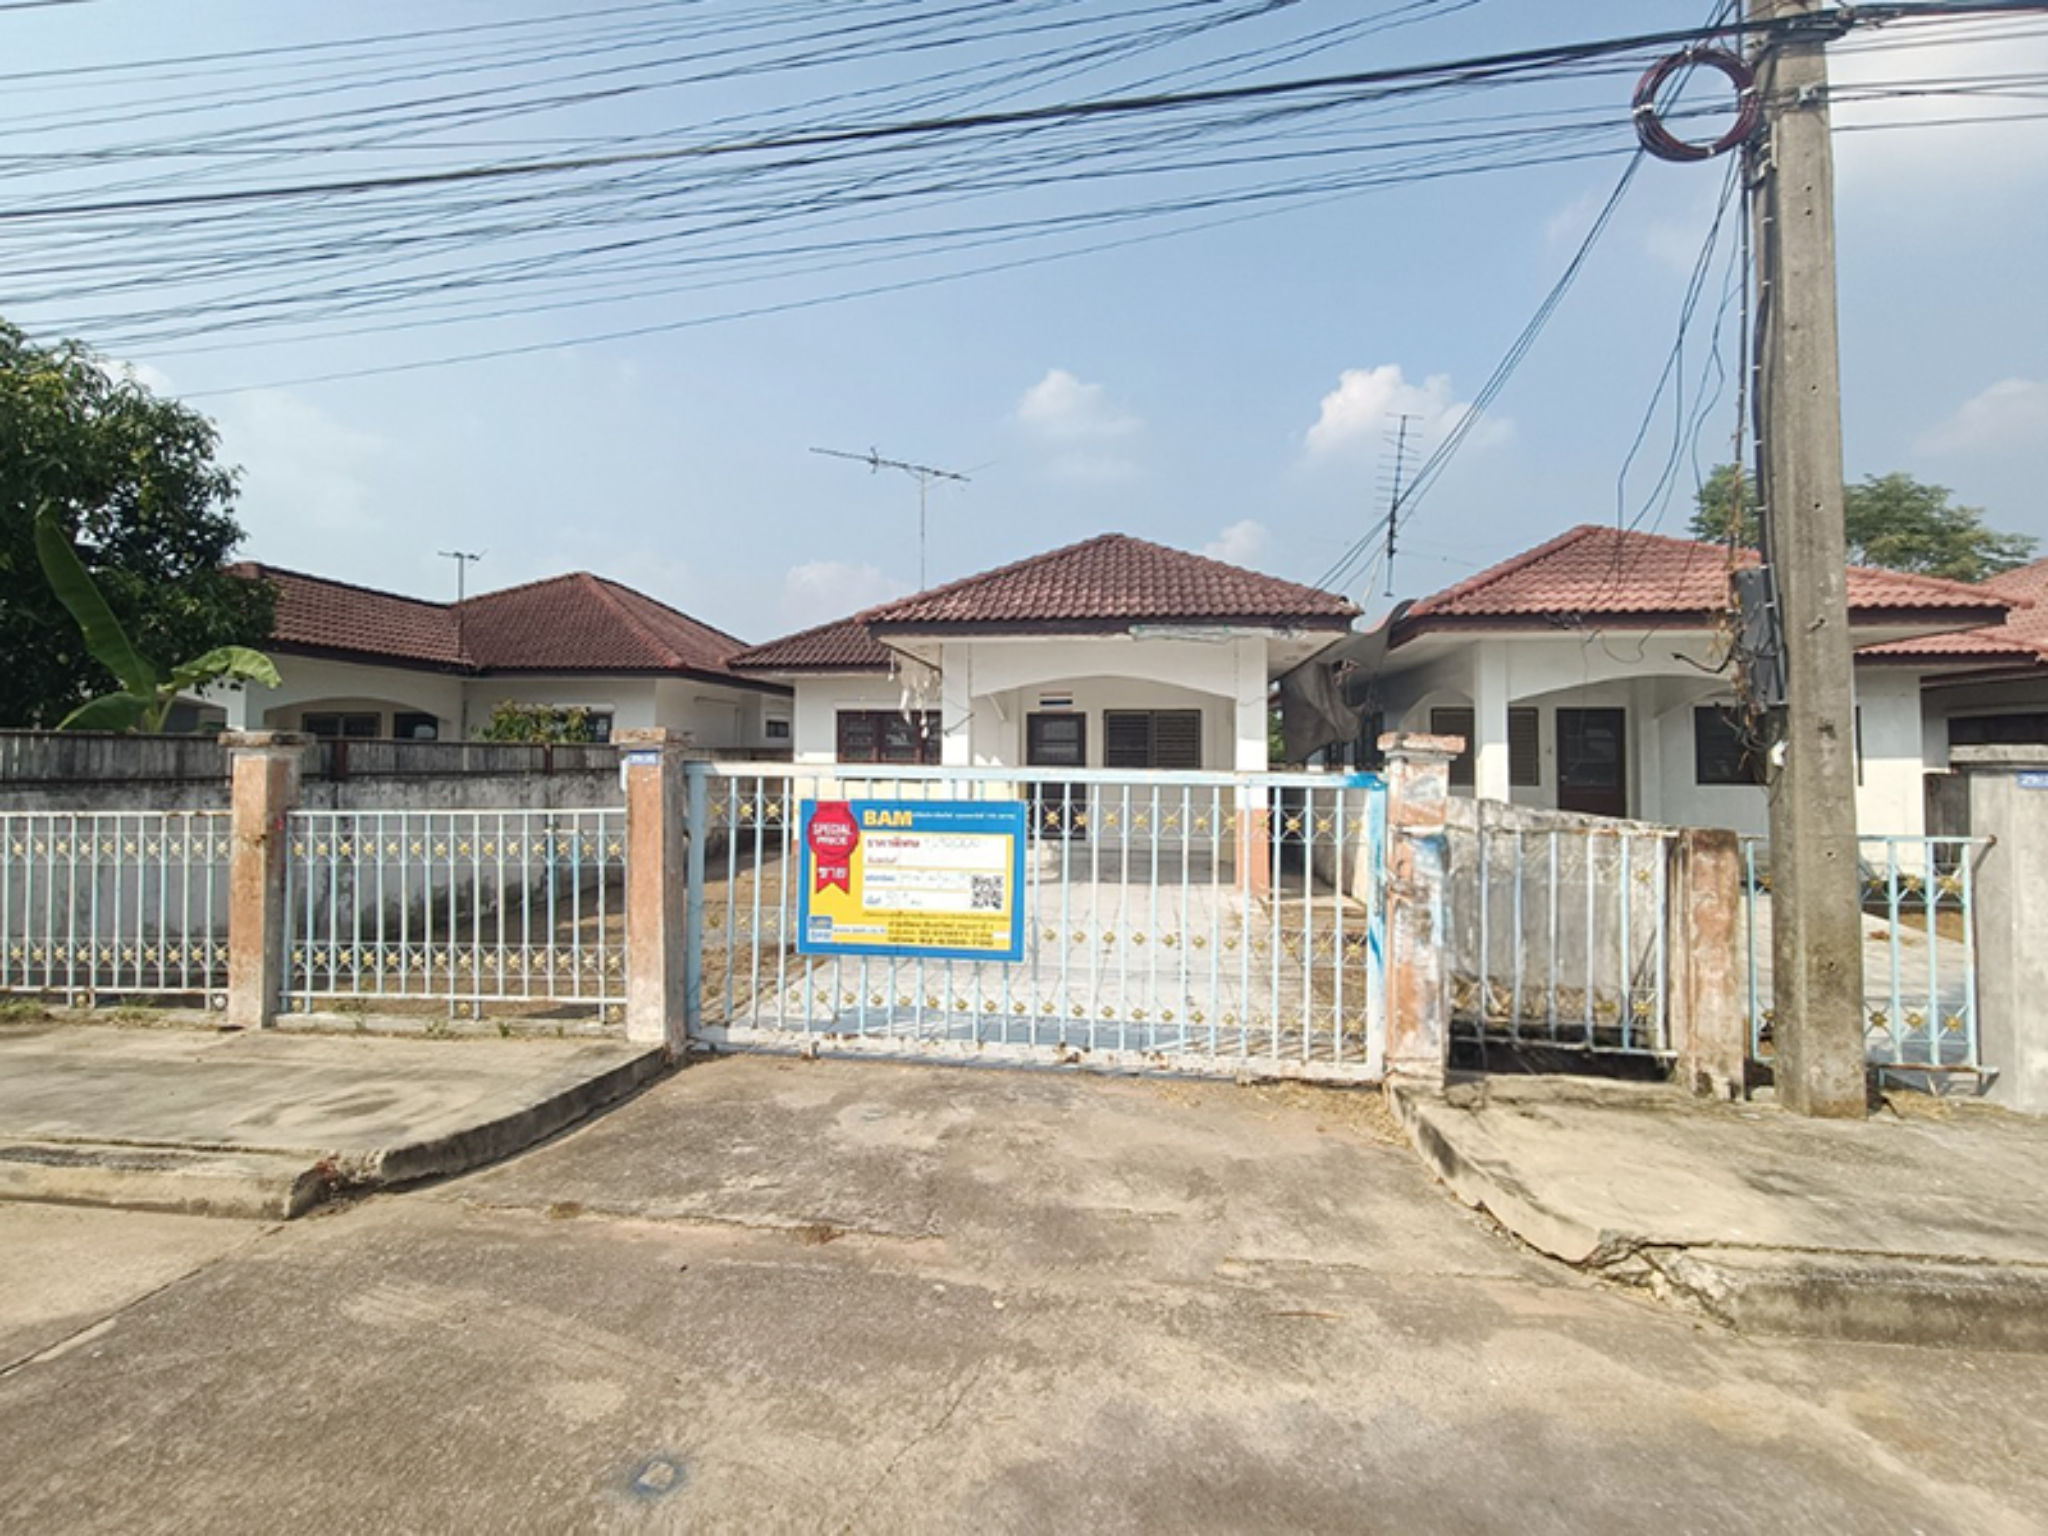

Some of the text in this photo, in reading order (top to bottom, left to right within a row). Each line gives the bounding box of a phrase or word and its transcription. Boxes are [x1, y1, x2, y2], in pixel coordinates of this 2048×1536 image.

[863, 809, 912, 827] BAM
[812, 823, 851, 836] SPECIAL
[816, 835, 848, 846] PRICE
[818, 866, 846, 880] ขาย
